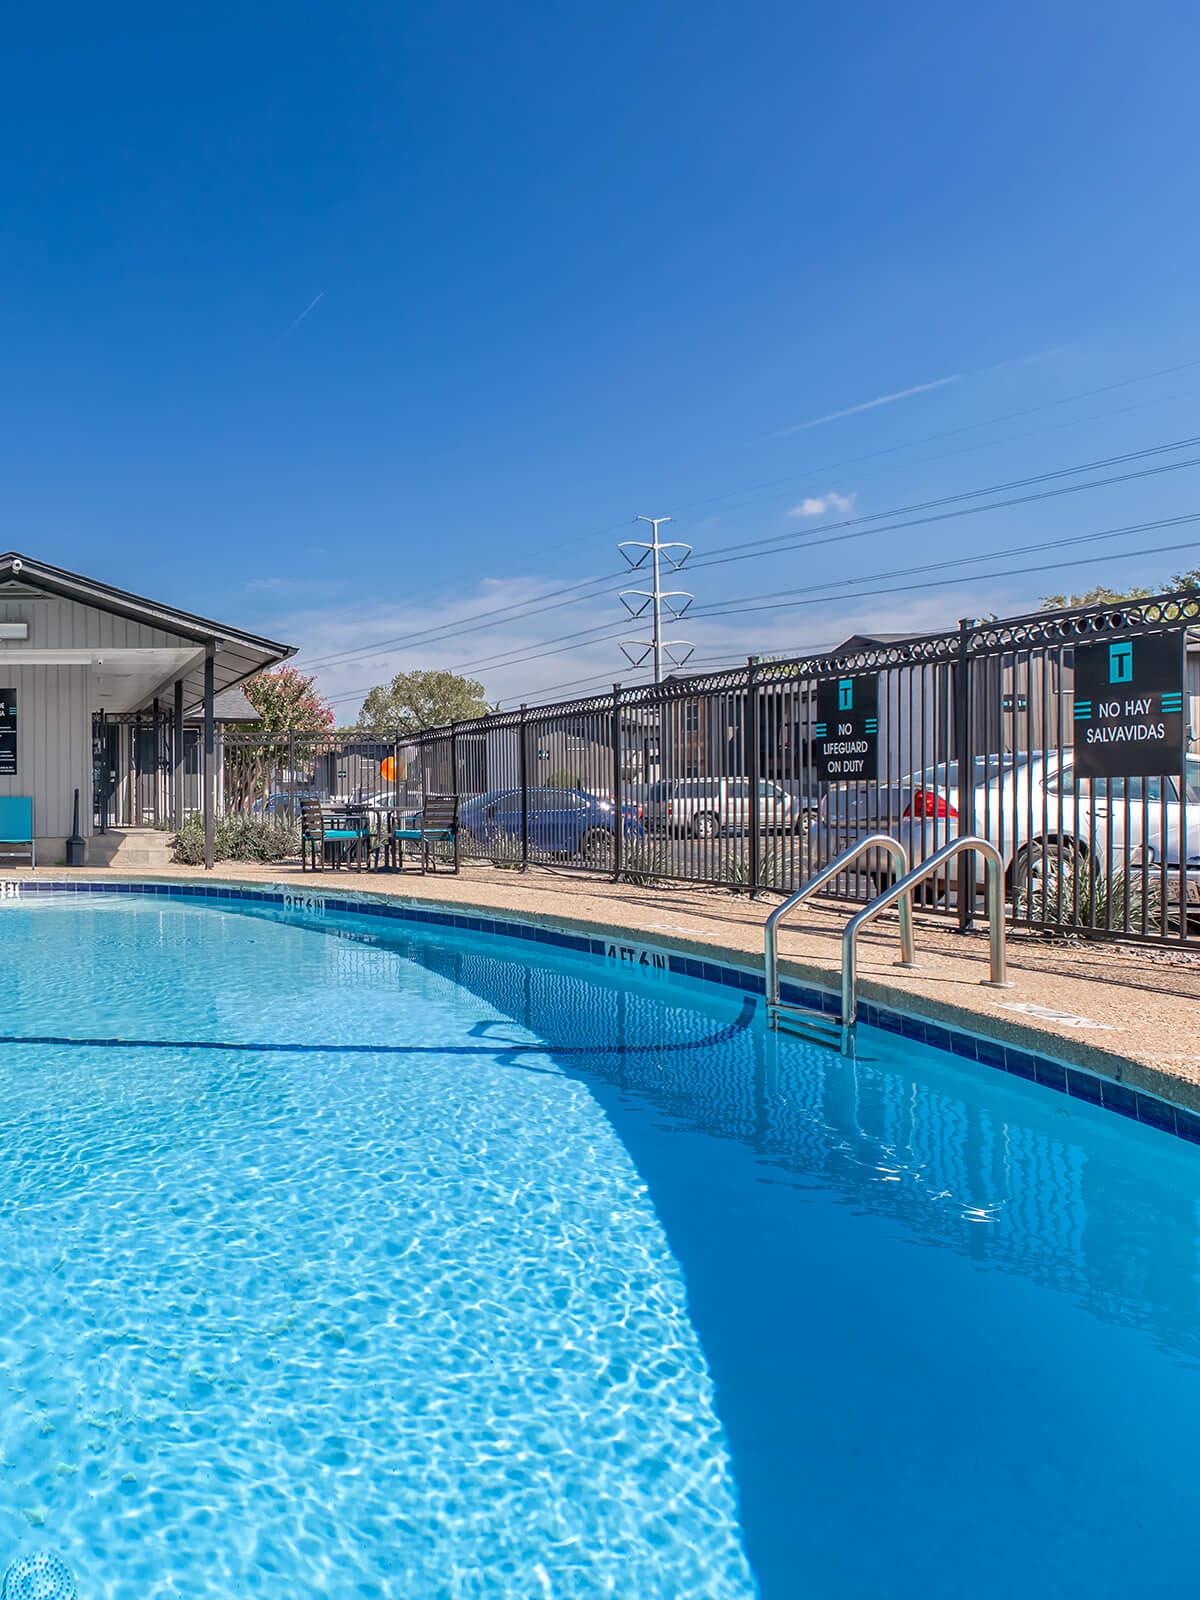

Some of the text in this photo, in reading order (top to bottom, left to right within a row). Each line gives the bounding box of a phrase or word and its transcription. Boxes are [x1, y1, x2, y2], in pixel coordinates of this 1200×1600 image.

[1098, 698, 1152, 718] NO HAY
[838, 723, 853, 736] NO
[1086, 723, 1165, 744] SALVAVIDAS
[823, 741, 868, 755] LIFEGUARD
[827, 760, 864, 773] ON DUTY
[5, 882, 18, 892] FT
